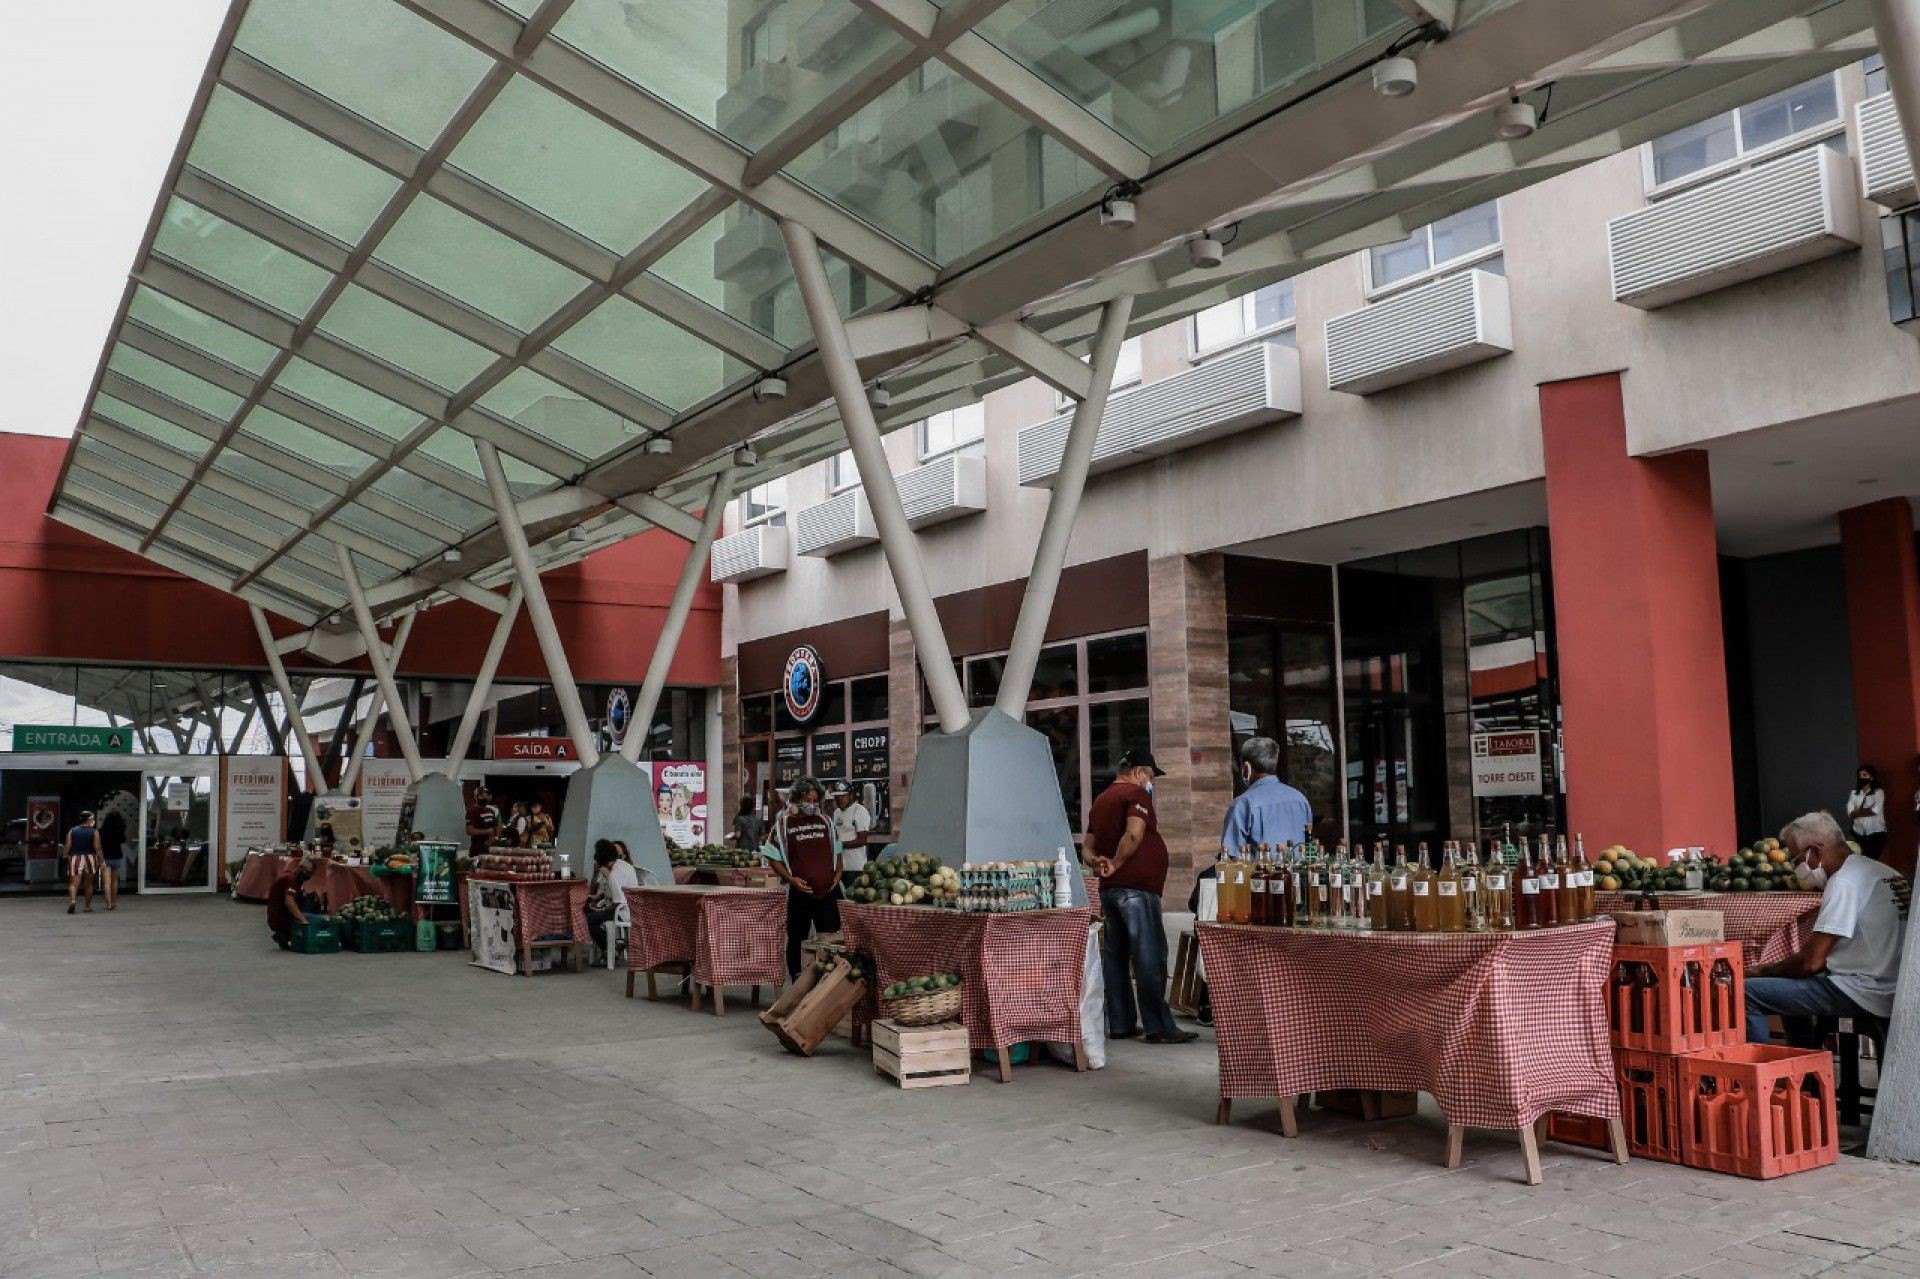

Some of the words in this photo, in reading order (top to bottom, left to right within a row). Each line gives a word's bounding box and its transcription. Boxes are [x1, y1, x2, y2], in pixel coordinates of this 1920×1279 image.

[25, 732, 101, 746] ENTRADA
[109, 734, 122, 747] A
[854, 735, 887, 749] CHOPP
[513, 741, 552, 756] SAÍDA
[556, 744, 567, 757] A
[233, 774, 276, 785] FEIRINHA
[1478, 773, 1506, 784] TORRE
[1508, 771, 1537, 782] OESTE
